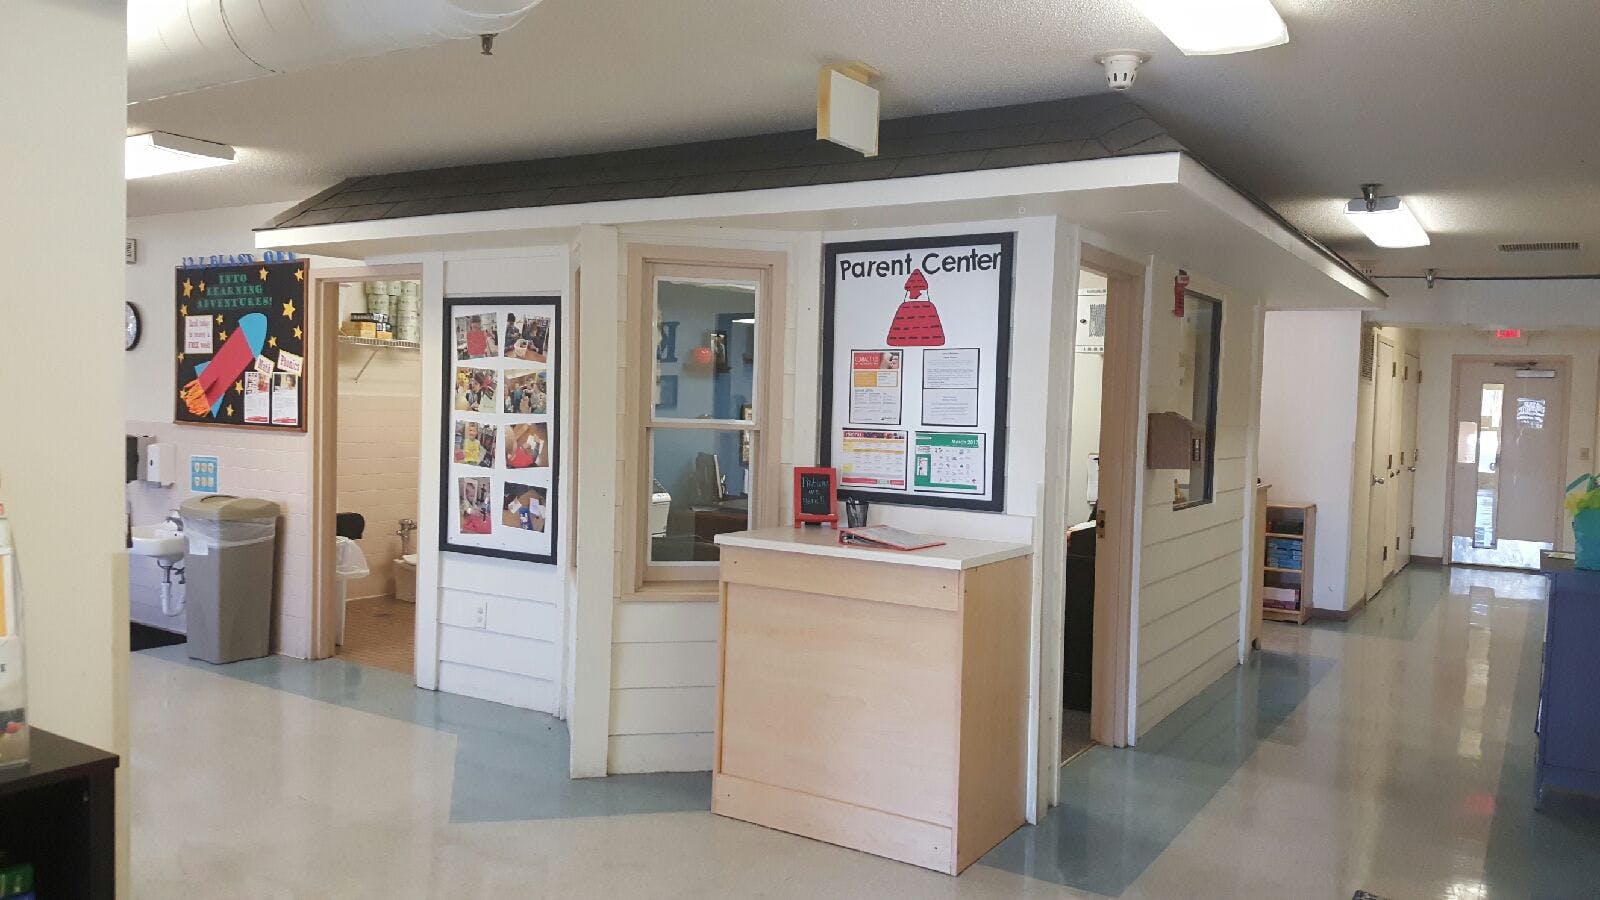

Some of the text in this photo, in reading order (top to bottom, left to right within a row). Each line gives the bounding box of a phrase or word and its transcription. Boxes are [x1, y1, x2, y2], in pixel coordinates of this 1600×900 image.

[840, 249, 1001, 281] Parent Center
[219, 275, 248, 284] INTO
[207, 285, 263, 297] LEARNING
[198, 297, 272, 309] ADVENTURES!
